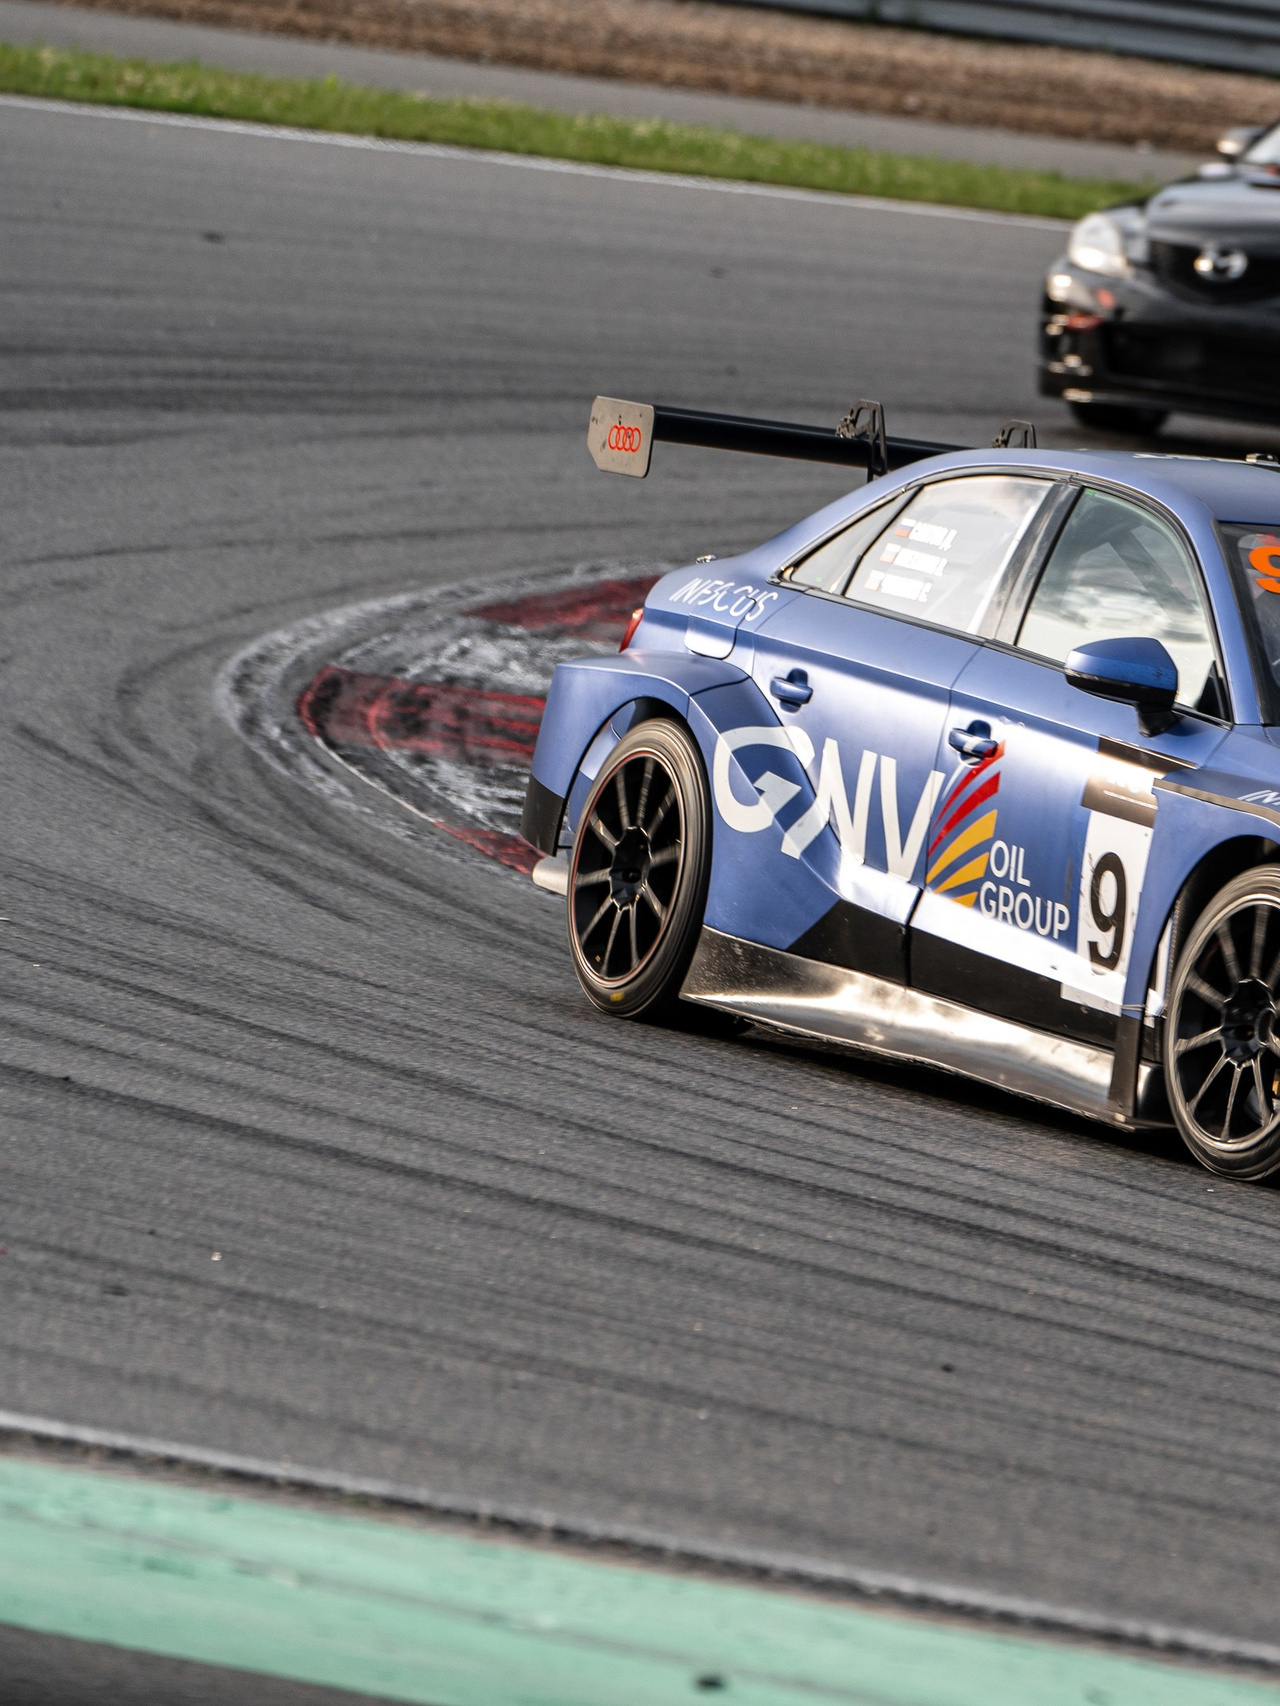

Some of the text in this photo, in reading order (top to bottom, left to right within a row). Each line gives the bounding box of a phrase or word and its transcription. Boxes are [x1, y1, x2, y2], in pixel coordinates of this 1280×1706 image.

[712, 725, 946, 881] GNV
[989, 840, 1031, 887] OIL
[979, 881, 1070, 939] GROUP
[1087, 851, 1127, 975] 9
